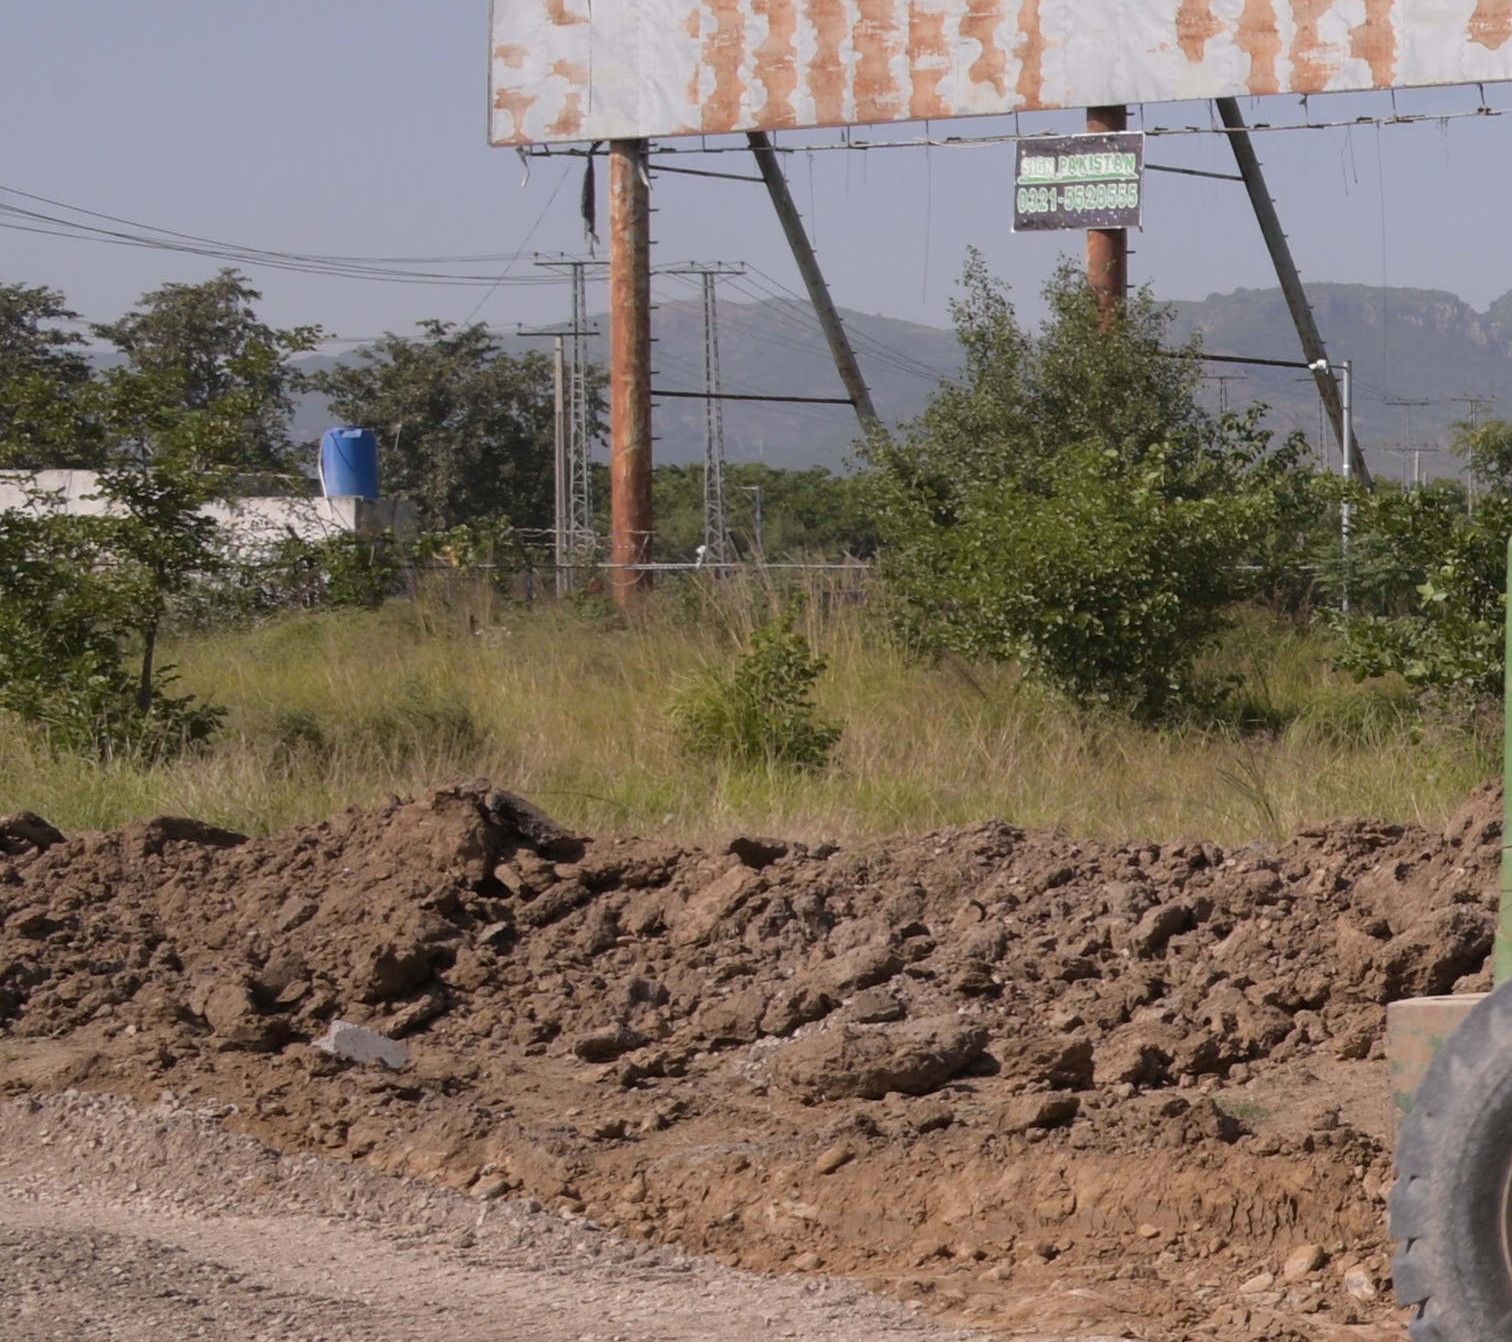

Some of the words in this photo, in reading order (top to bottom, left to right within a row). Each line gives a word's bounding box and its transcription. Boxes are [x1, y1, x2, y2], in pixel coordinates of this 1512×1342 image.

[1020, 156, 1056, 177] SIGN
[1058, 152, 1136, 178] PAKISTAN
[1016, 183, 1139, 214] 0321-5528555
